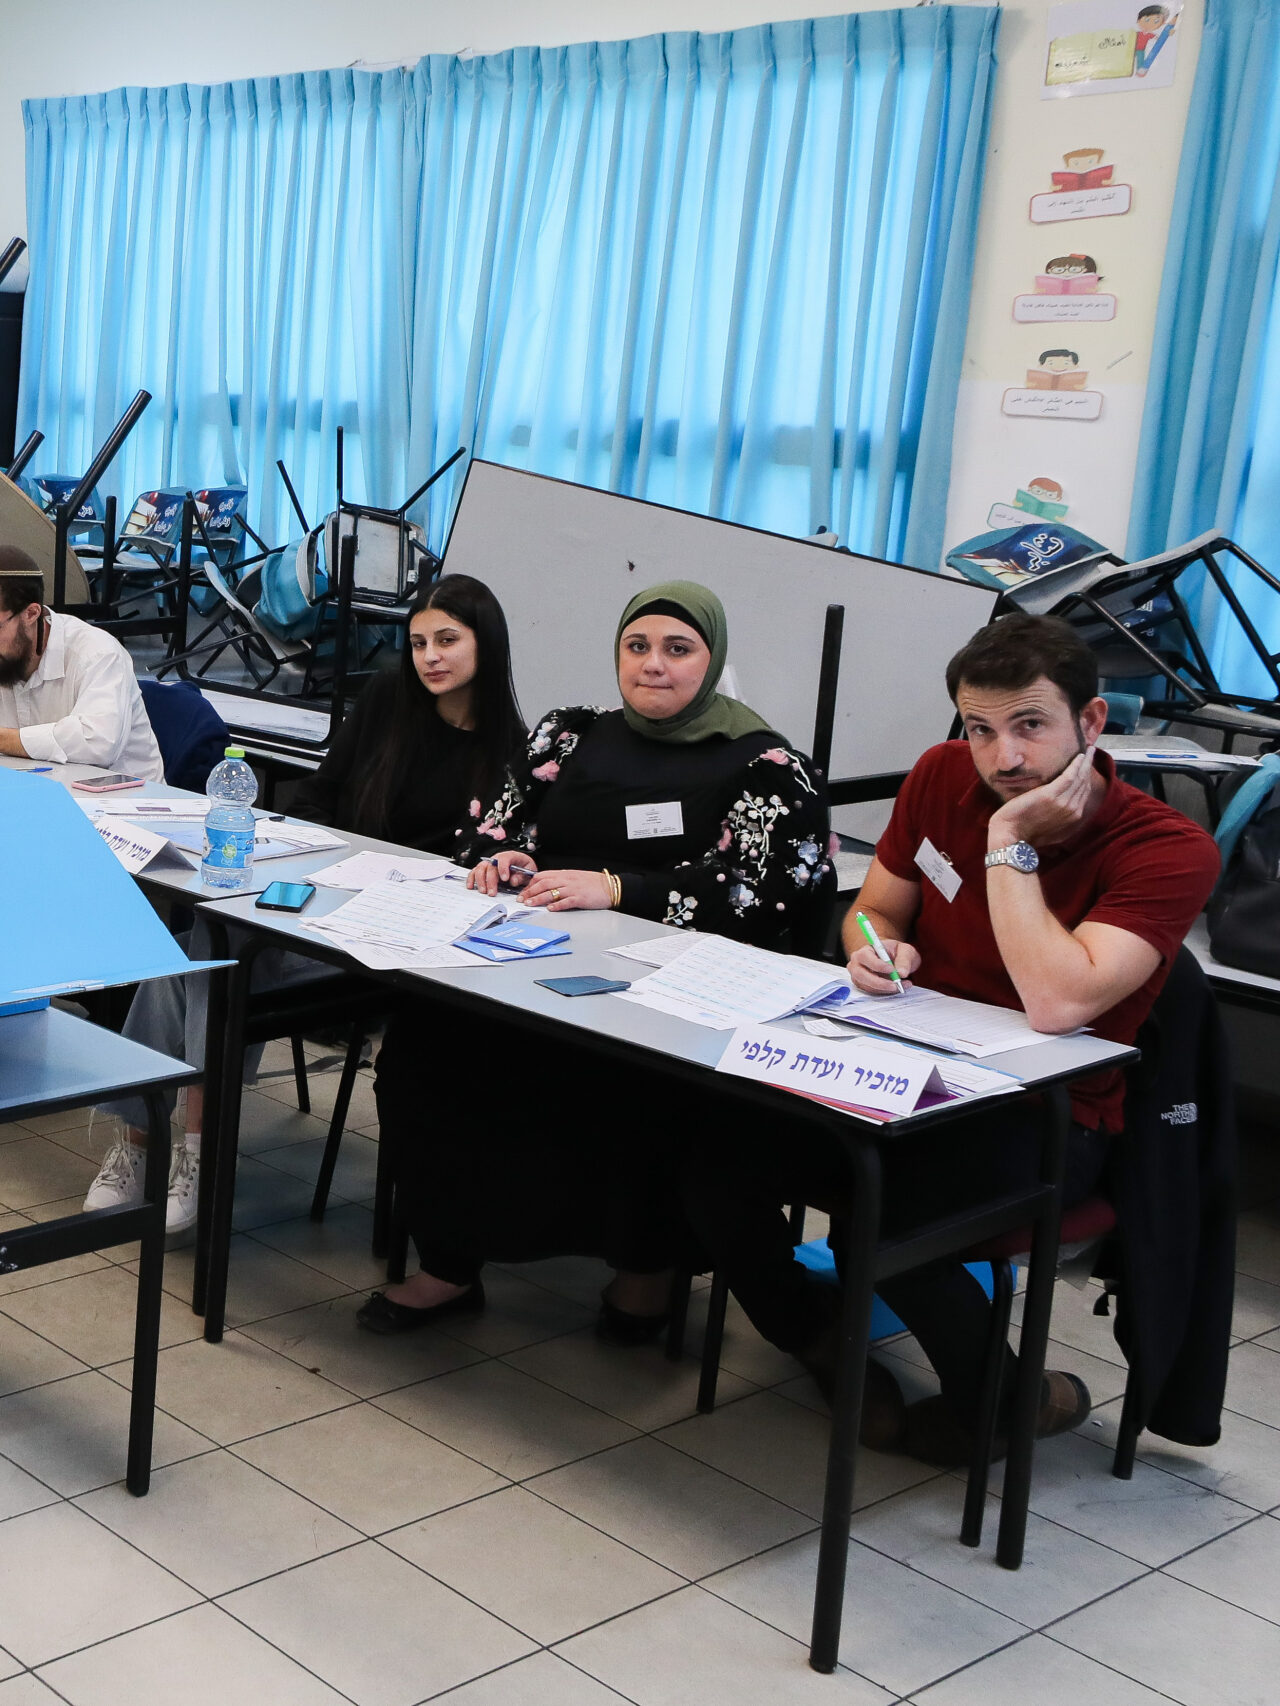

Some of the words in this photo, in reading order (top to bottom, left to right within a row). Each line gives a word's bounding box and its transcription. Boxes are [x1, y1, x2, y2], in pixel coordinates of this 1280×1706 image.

[740, 1039, 787, 1070] קלפי
[789, 1052, 845, 1080] ועדת
[854, 1066, 910, 1096] מזכיר
[1161, 1110, 1190, 1120] NORTH
[1172, 1104, 1189, 1112] THE
